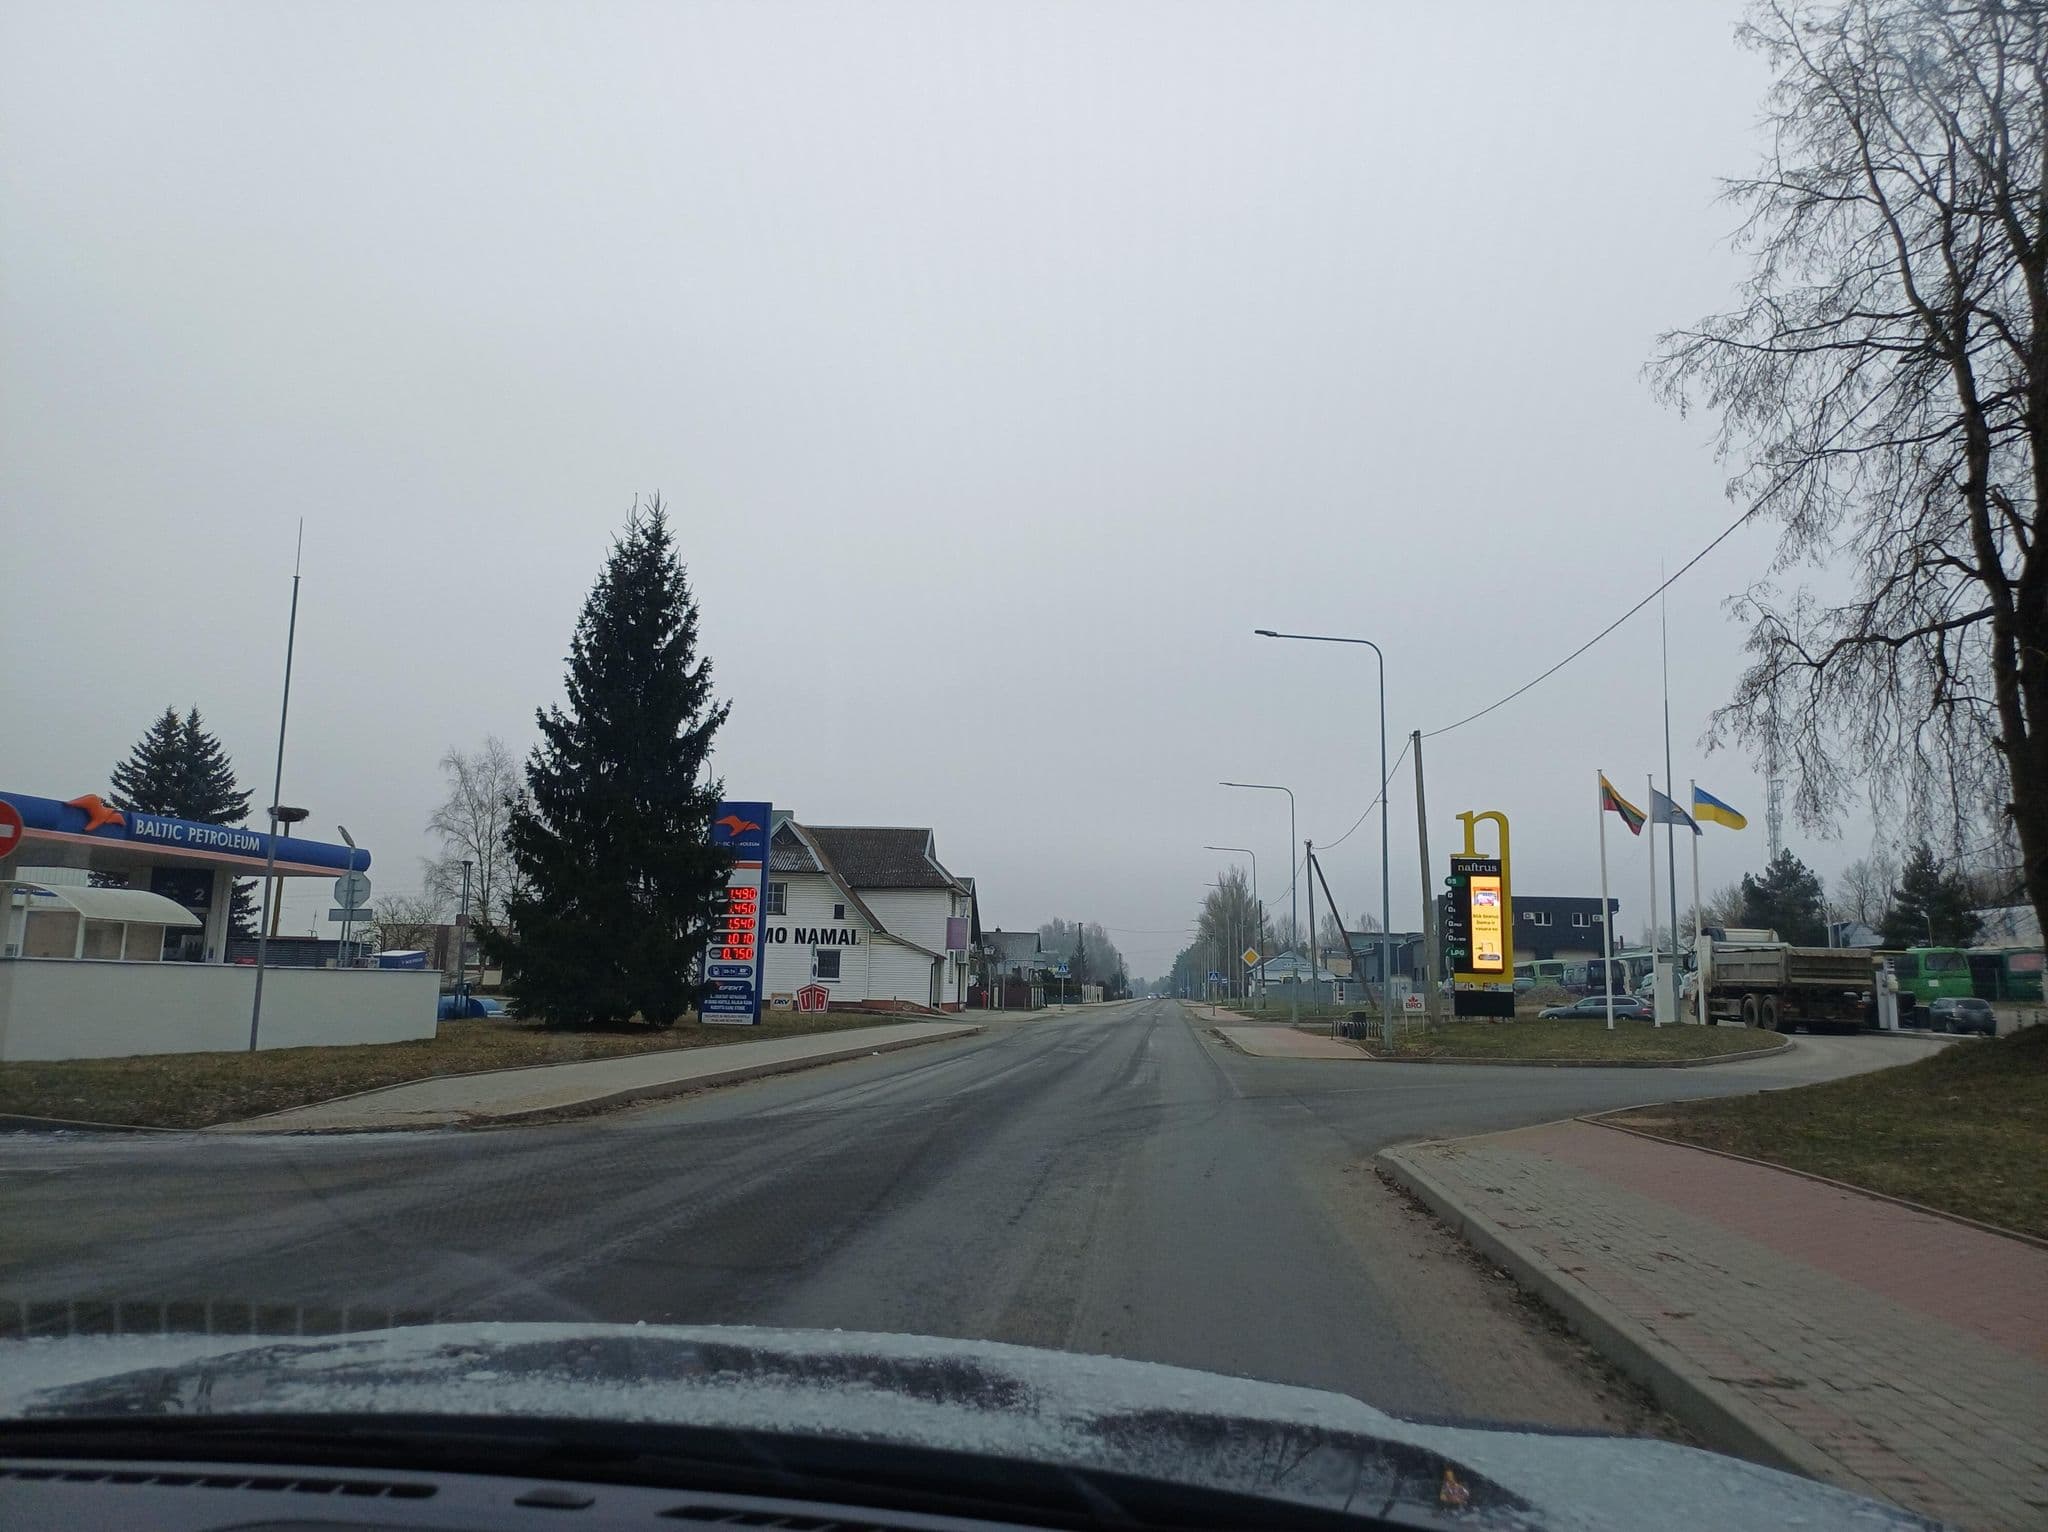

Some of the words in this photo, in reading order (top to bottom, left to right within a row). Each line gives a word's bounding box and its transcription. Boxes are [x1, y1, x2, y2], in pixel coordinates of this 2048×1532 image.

[136, 819, 184, 841] BALTIC
[187, 827, 260, 852] PETROLEUM
[1458, 862, 1497, 872] naftrus
[195, 888, 205, 901] 2
[794, 928, 857, 945] NAMAI
